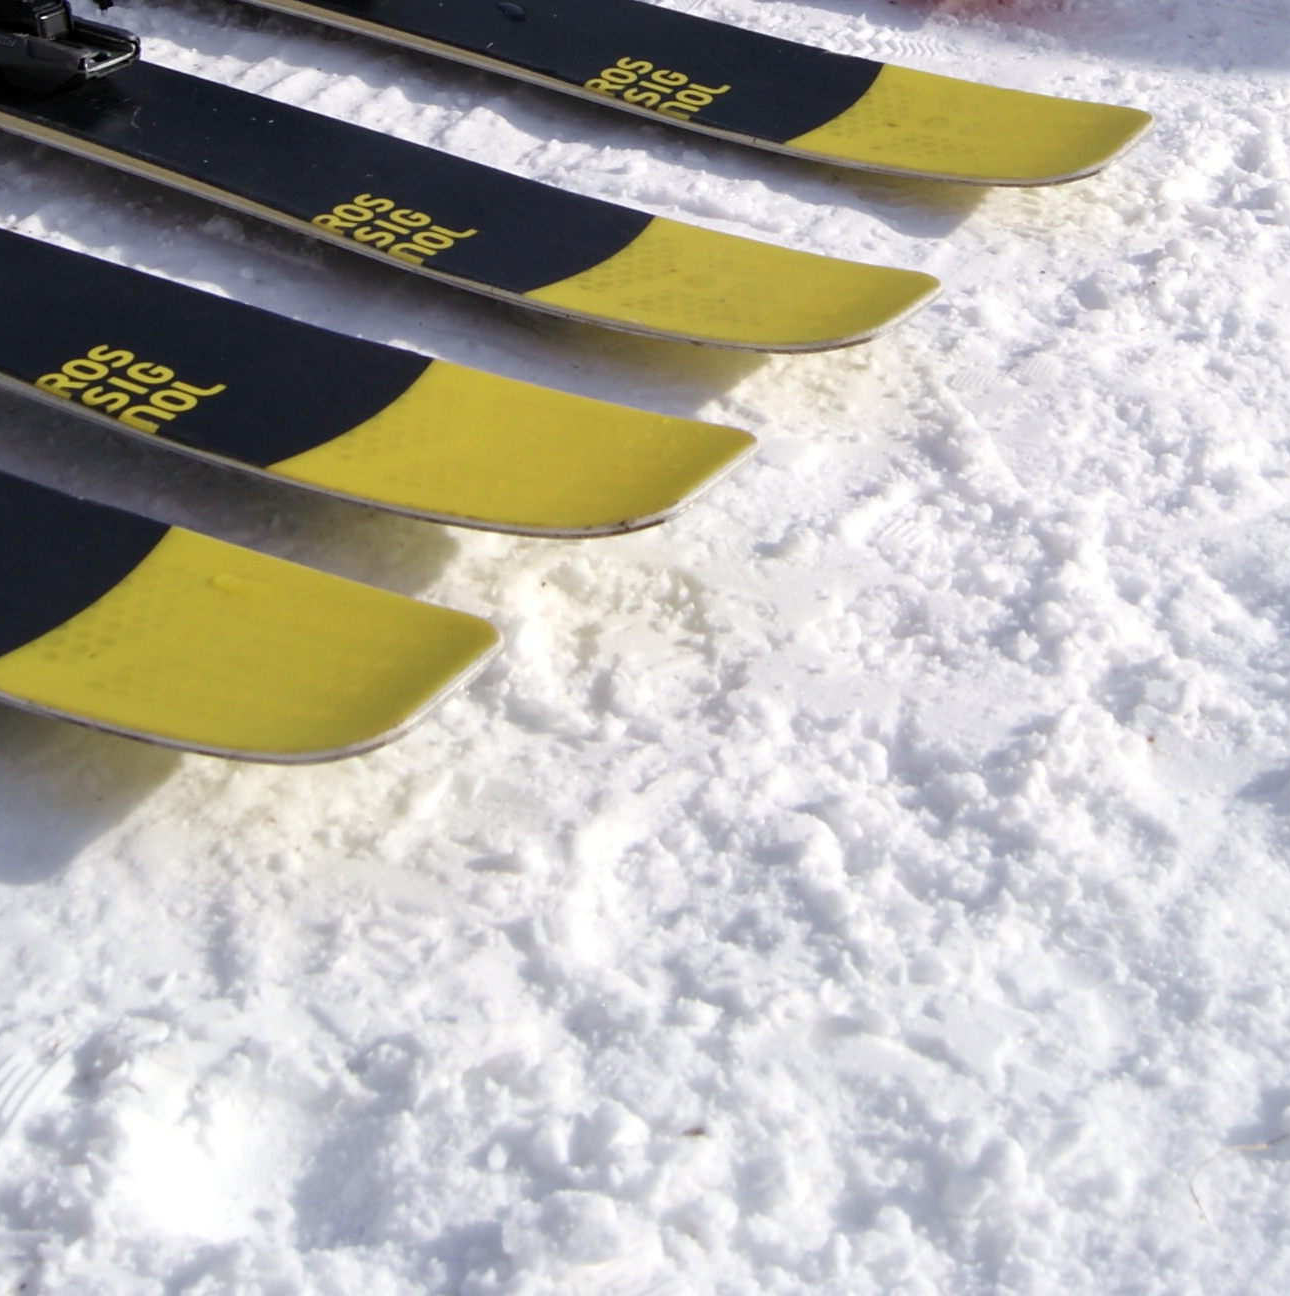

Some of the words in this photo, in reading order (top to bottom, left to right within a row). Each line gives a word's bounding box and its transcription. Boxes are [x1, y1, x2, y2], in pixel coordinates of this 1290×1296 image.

[583, 56, 654, 97] ROS
[622, 69, 689, 108] SIG
[311, 193, 395, 235] ROS
[353, 209, 432, 249] SIG
[34, 344, 135, 399] ROS
[81, 362, 175, 413] SIG
